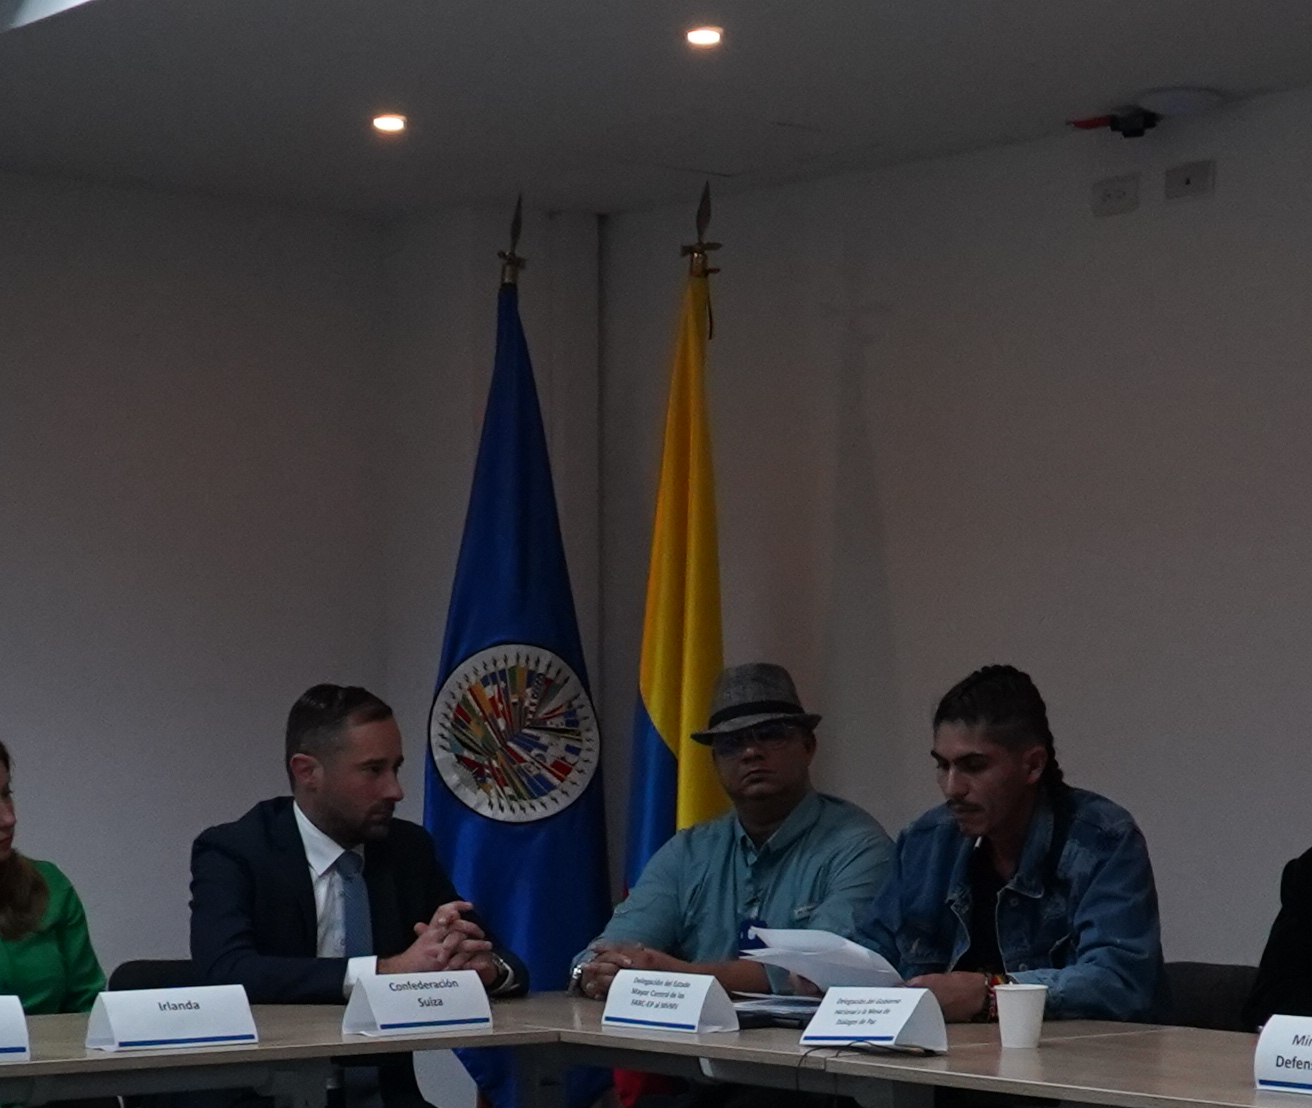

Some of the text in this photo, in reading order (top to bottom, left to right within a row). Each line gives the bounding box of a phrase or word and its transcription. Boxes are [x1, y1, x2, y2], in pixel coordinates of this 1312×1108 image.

[388, 978, 459, 992] Confederación
[158, 1000, 201, 1012] Irlanda
[418, 997, 444, 1007] Suiza
